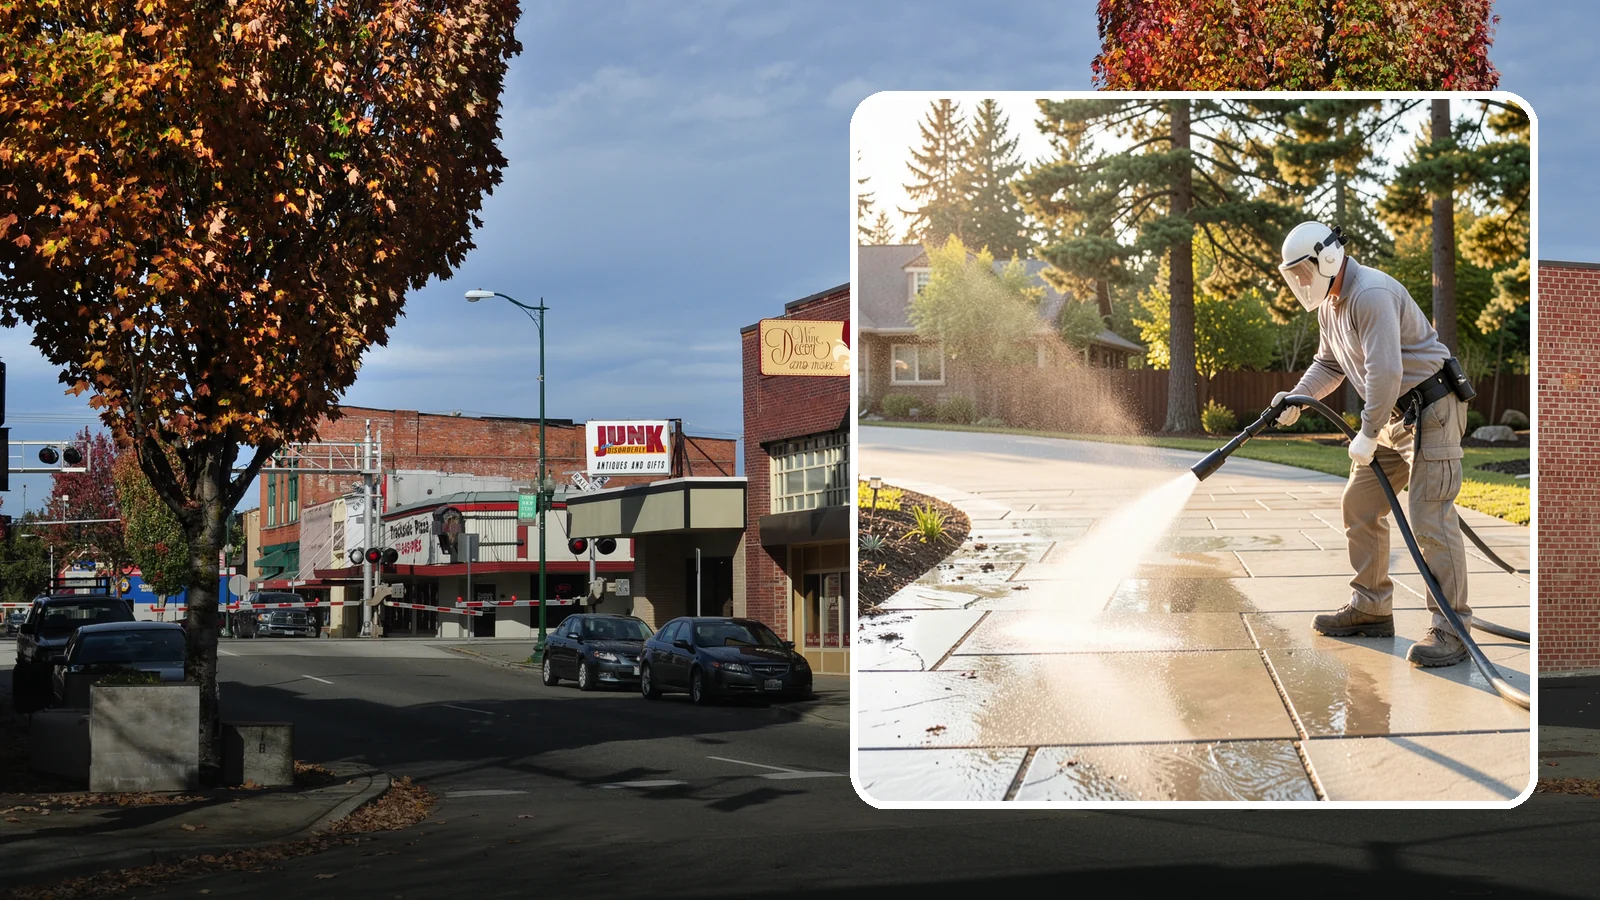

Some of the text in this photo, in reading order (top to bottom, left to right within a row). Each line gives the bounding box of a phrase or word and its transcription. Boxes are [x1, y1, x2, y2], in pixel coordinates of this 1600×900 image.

[764, 327, 831, 365] Decor
[595, 425, 664, 457] JUNK
[607, 446, 646, 454] DISORDERLY
[597, 460, 665, 470] ANTIQUES AND GIFTS
[573, 473, 588, 491] RAIL
[414, 519, 429, 535] Pizza
